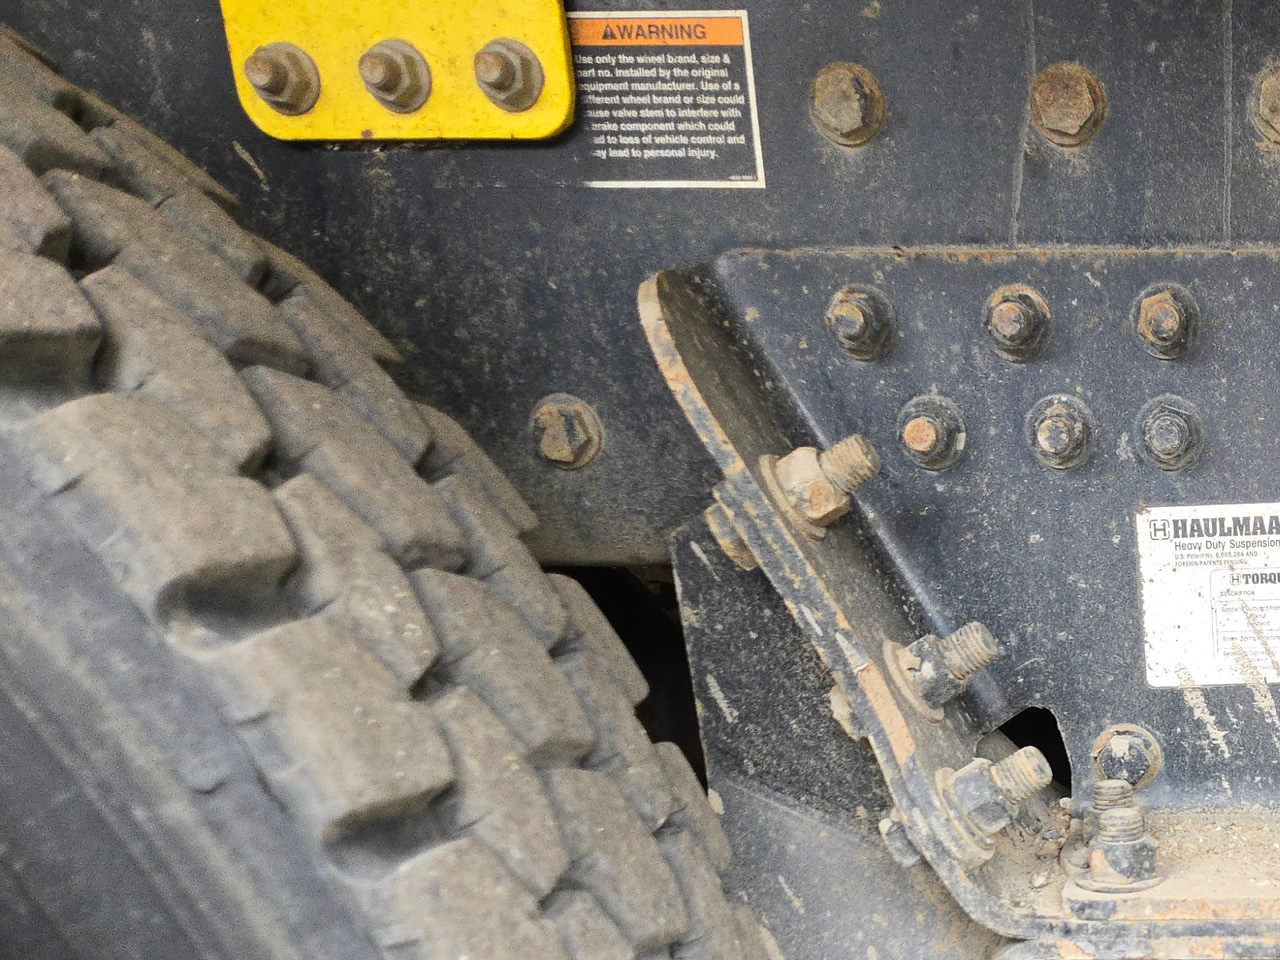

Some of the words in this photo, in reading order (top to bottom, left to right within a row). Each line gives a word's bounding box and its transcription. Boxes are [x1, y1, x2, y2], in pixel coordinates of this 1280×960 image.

[617, 24, 706, 40] WARNING
[574, 54, 593, 64] Use
[595, 53, 616, 66] only
[618, 53, 635, 64] the
[637, 53, 665, 64] wheel
[667, 53, 699, 65] brand,
[701, 54, 720, 64] size
[722, 53, 731, 64] &
[598, 69, 613, 77] no.
[658, 67, 671, 79] by
[673, 67, 689, 77] the
[691, 67, 728, 79] original
[631, 81, 699, 91] manufacturer.
[701, 81, 719, 91] Use
[722, 80, 732, 91] of
[733, 83, 740, 91] a
[621, 94, 650, 104] wheel
[652, 94, 681, 104] brand
[696, 95, 716, 104] size
[717, 94, 745, 104] could
[612, 108, 638, 117] valve
[639, 108, 664, 117] stem
[665, 108, 676, 117] to
[678, 107, 719, 118] interfere
[721, 107, 742, 118] with
[620, 123, 675, 133] component
[677, 121, 706, 131] which
[708, 121, 735, 131] could
[607, 135, 617, 144] to
[618, 134, 640, 144] loss
[641, 134, 652, 144] of
[654, 134, 689, 144] vehicle
[691, 134, 725, 144] control
[727, 134, 745, 144] and
[608, 147, 630, 157] lead
[631, 147, 642, 157] to
[643, 147, 686, 159] personal
[688, 147, 719, 159] injury.
[1174, 541, 1202, 552] Heavy
[1205, 540, 1226, 551] Duty
[1229, 539, 1280, 550] Suspension
